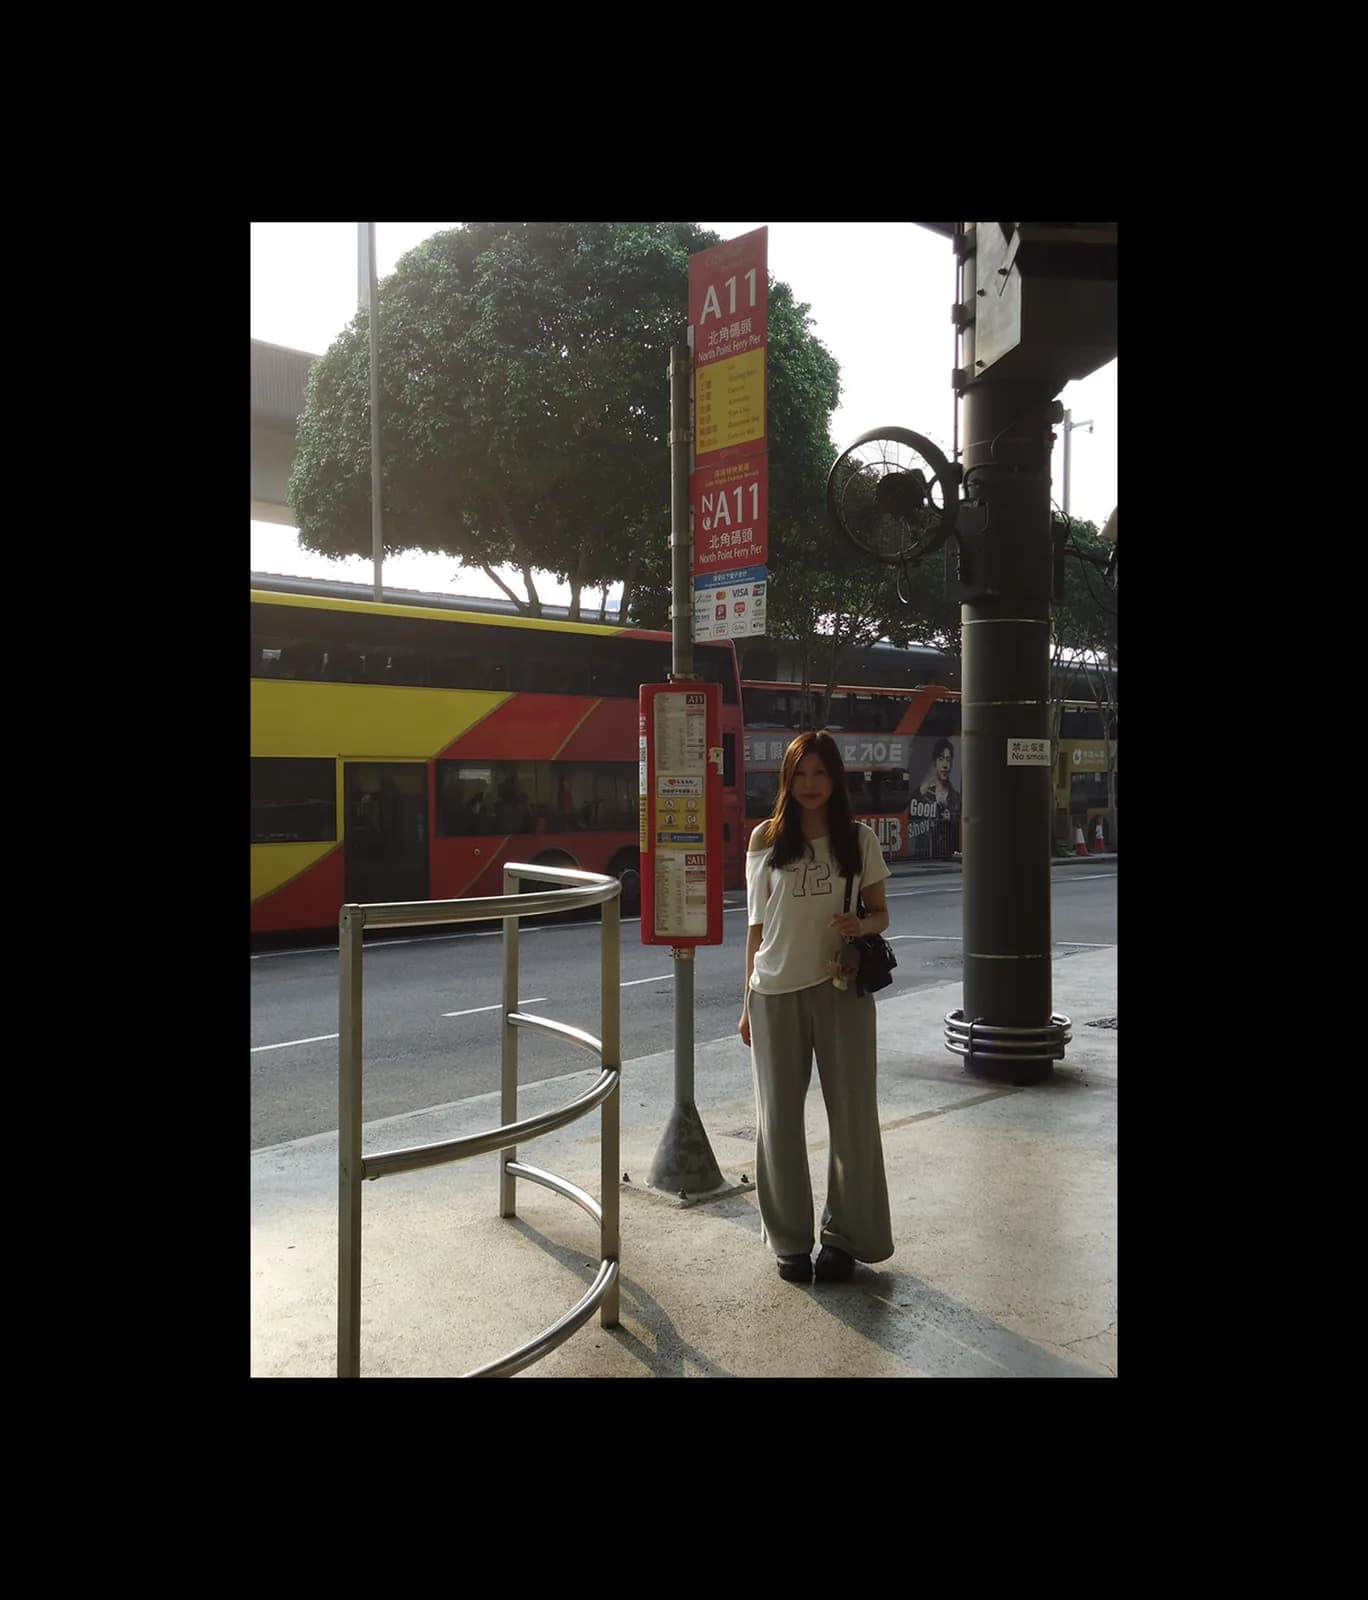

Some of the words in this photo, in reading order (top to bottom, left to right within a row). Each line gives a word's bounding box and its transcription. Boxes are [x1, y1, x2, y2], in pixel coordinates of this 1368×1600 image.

[700, 268, 757, 325] A11
[708, 318, 752, 346] 北角碼頭
[698, 350, 716, 362] North
[716, 344, 732, 356] Point
[732, 340, 748, 352] Ferry
[749, 335, 761, 345] Pier
[709, 528, 753, 549] 北角碼頭
[700, 551, 717, 564] North
[717, 549, 734, 561] Point
[735, 546, 749, 559] Ferry
[751, 544, 762, 555] Pier
[732, 588, 749, 598] VISA
[688, 695, 704, 704] A11
[1011, 753, 1025, 761] No
[910, 798, 937, 818] Good
[785, 863, 833, 897] 72
